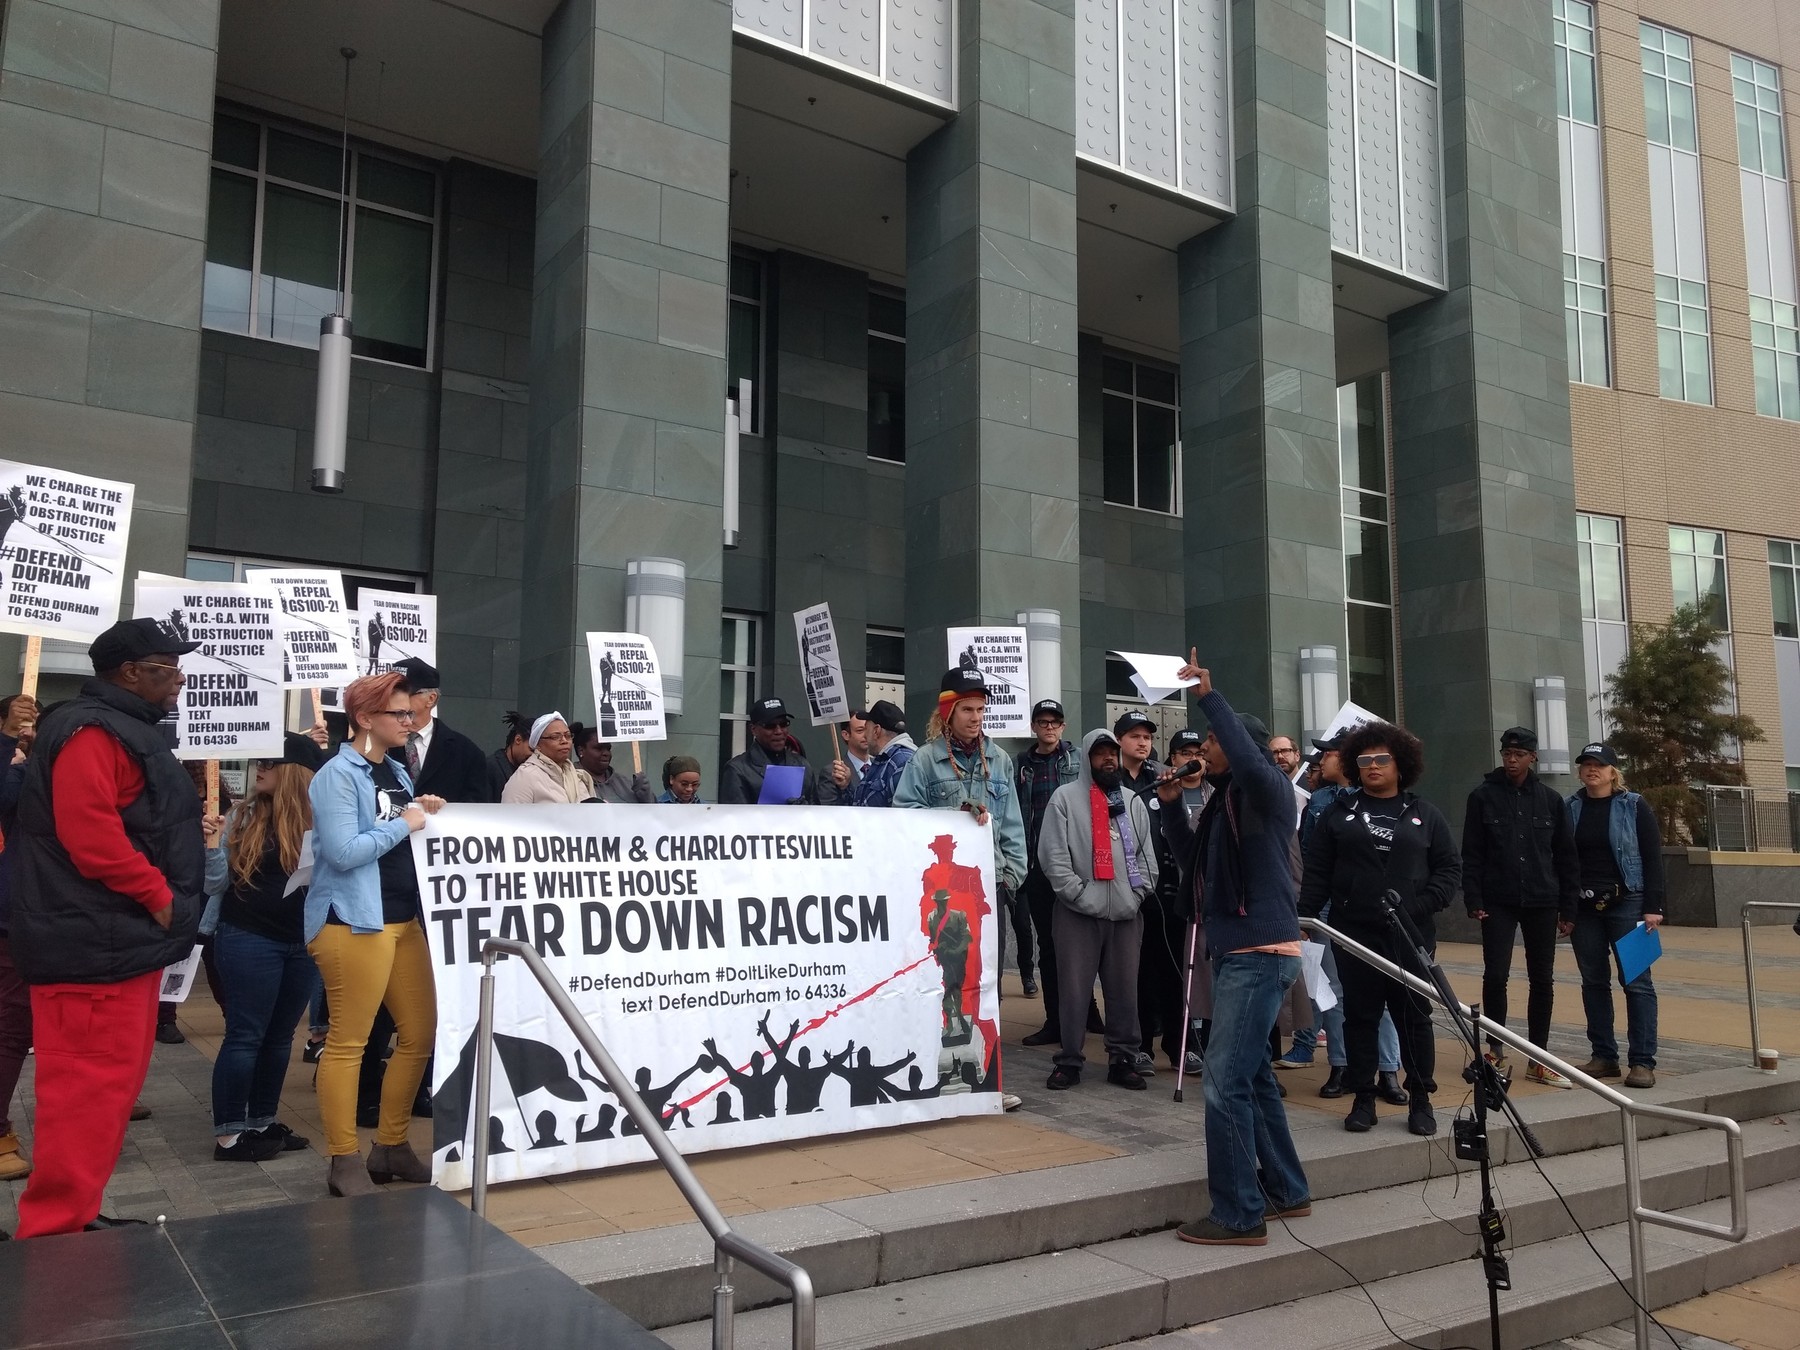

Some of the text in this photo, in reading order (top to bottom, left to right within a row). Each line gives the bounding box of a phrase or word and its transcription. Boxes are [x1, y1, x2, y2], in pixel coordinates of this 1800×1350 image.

[26, 474, 122, 503] WE CHARGE THE
[82, 501, 115, 517] WITH
[29, 505, 117, 532] OBSTRUCTION
[38, 522, 105, 545] OF JUSTICE
[11, 563, 91, 590] DURHAM
[12, 582, 38, 594] TEXT
[293, 586, 331, 598] REPEAL
[9, 594, 100, 616] DEFEND DURHAM
[183, 595, 273, 609] WE CHARGE THE
[289, 599, 339, 613] GS100-2!
[386, 601, 400, 609] DOWN
[7, 606, 62, 623] TO 64336
[239, 613, 269, 624] WITH
[391, 611, 422, 626] REPEAL
[192, 628, 273, 641] OBSTRUCTION
[387, 626, 427, 643] GS100-2!
[203, 644, 265, 656] OF JUSTICE
[291, 642, 338, 653] DURHAM
[620, 650, 649, 660] REPEAL
[616, 662, 655, 674] GS100-2!
[985, 666, 993, 674] OF
[186, 673, 248, 690] DEFEND
[186, 691, 258, 707] DURHAM
[610, 690, 646, 701] #DEFEND
[985, 695, 1016, 705] URHAM
[618, 701, 652, 711] DURHAM
[188, 710, 212, 720] TEXT
[188, 721, 270, 733] DEFEND DURHAM
[188, 735, 238, 746] TO 64336
[426, 834, 853, 866] FROM DURHAM & CHARLOTTESVILLE
[428, 869, 698, 904] TO THE WHITE HOUSE
[431, 894, 889, 965] TEAR DOWN RACISM
[569, 962, 846, 992] #DefendDurham #DoItLikeDurham
[622, 983, 846, 1013] text DefendDurham to 64336
